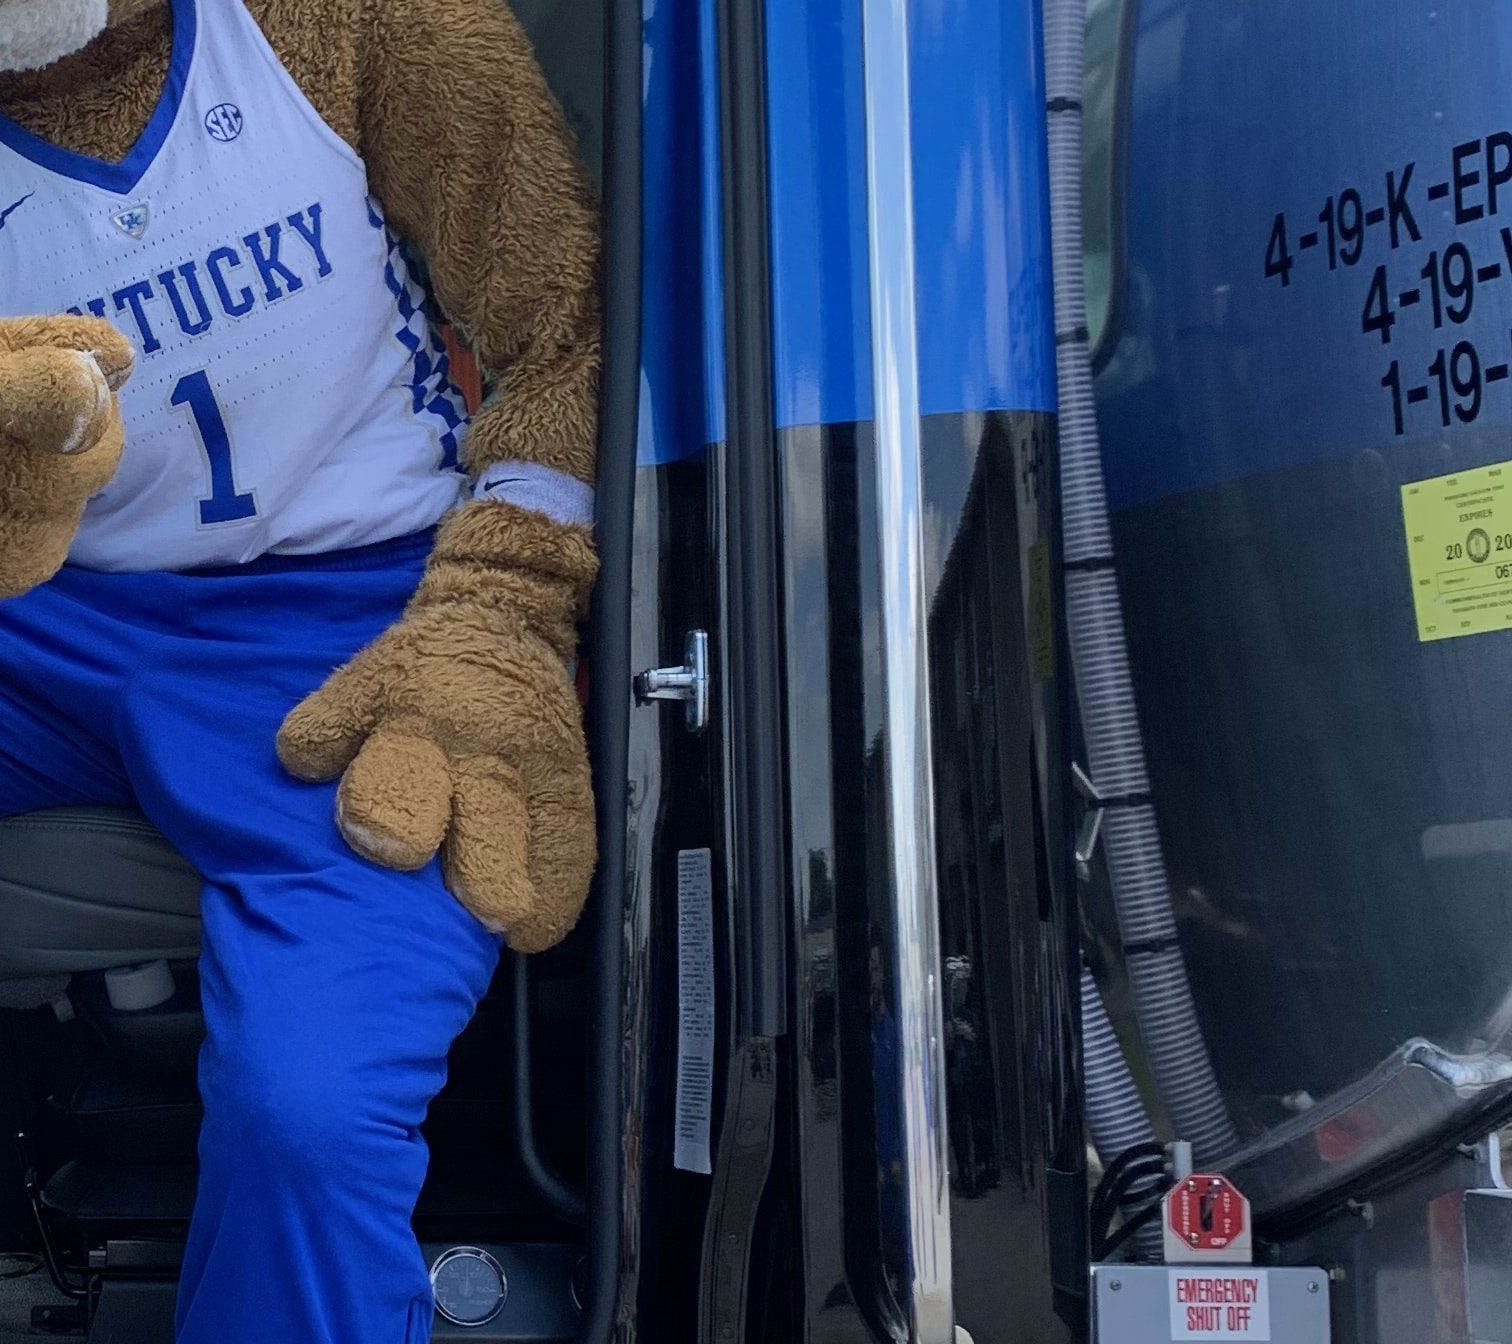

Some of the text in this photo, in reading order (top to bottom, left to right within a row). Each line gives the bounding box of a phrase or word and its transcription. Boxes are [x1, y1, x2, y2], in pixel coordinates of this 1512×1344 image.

[206, 104, 243, 141] SEC
[66, 202, 333, 354] TUCKY
[1361, 228, 1512, 344] 4-19-
[170, 369, 257, 523] 1
[1459, 508, 1493, 523] EXPIRES
[1445, 533, 1512, 560] 20 20
[1177, 1279, 1258, 1303] EMERGENCY
[1187, 1306, 1251, 1331] SHUT OFF
